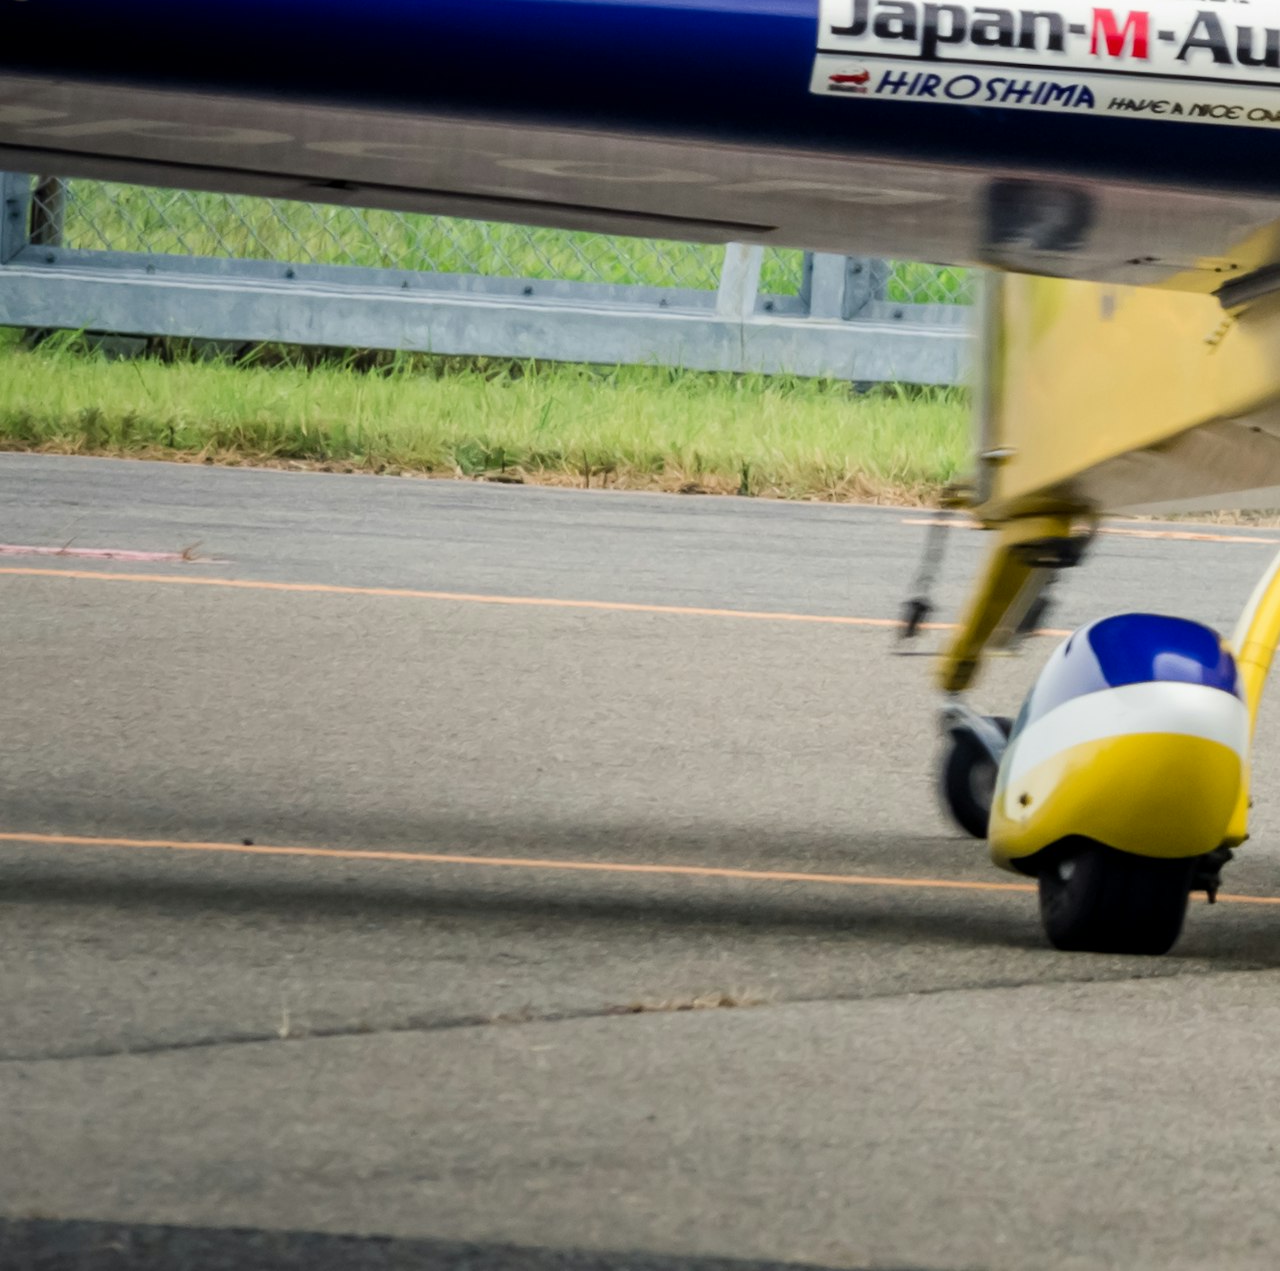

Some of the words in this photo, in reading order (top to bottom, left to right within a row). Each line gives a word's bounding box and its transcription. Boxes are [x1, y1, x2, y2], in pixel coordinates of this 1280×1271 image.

[874, 69, 1095, 109] HIROSHIMA
[1107, 96, 1170, 114] HAVE
[1171, 102, 1184, 115] A
[1188, 103, 1243, 120] NICE
